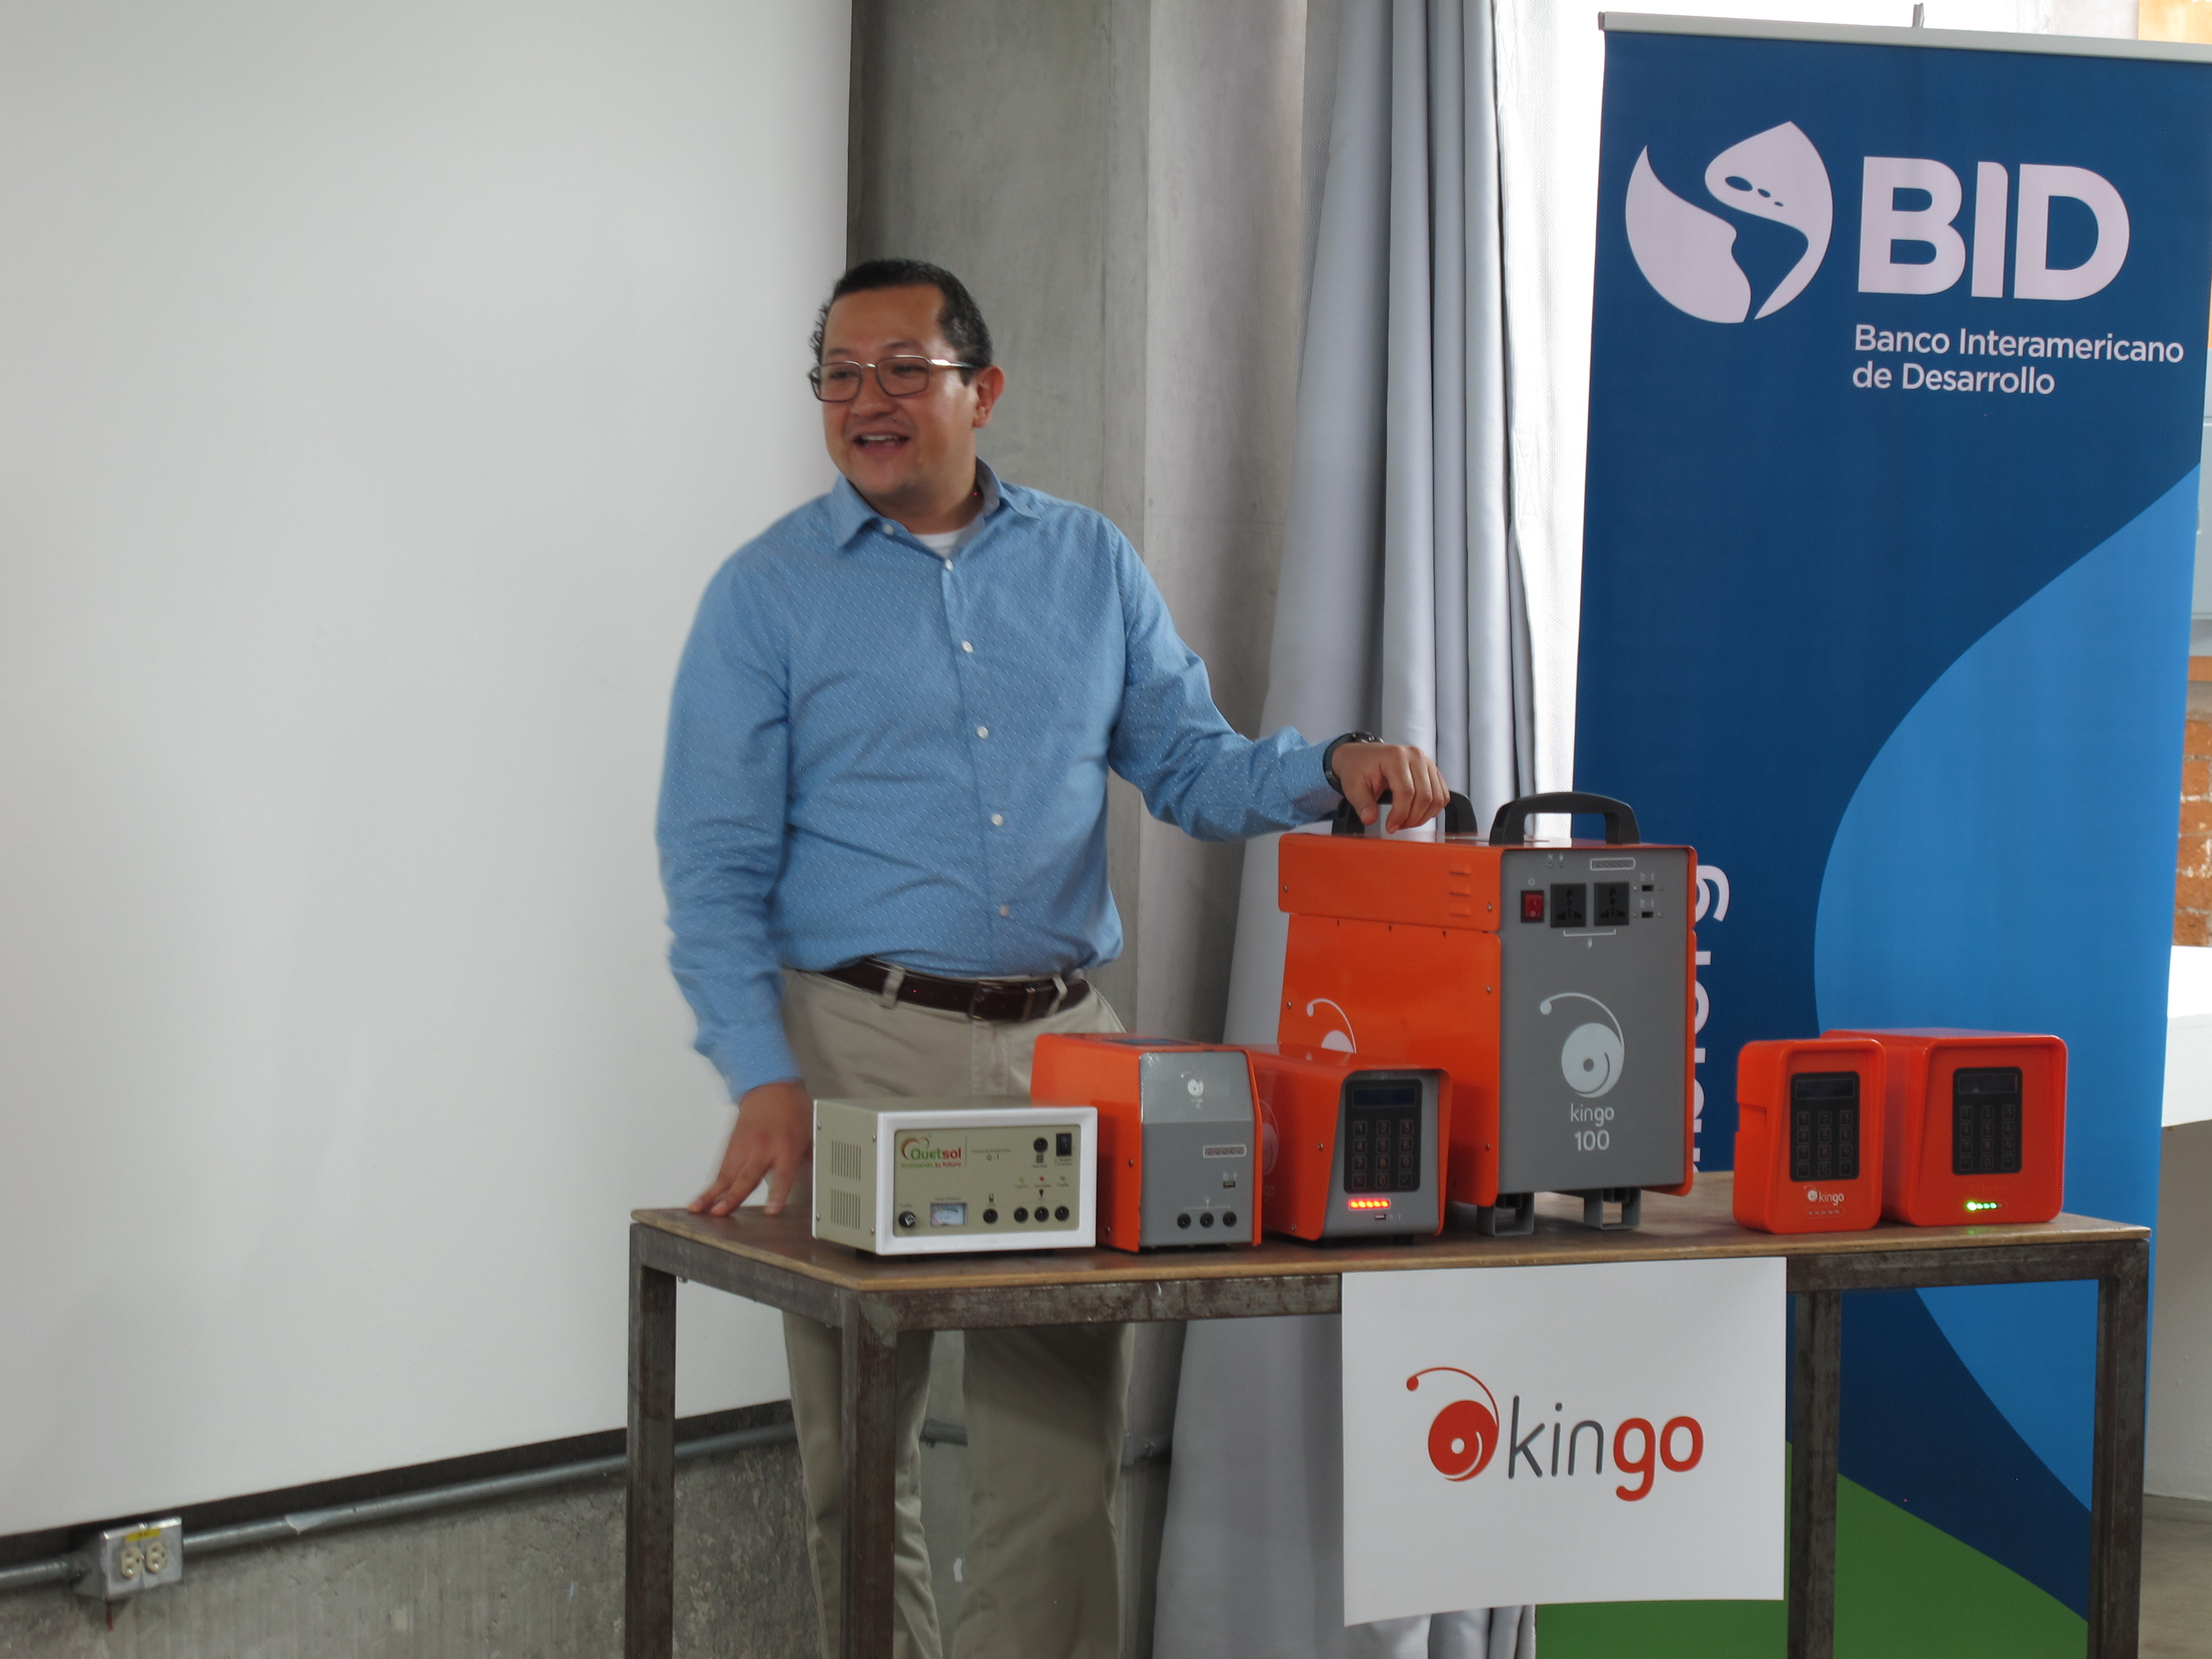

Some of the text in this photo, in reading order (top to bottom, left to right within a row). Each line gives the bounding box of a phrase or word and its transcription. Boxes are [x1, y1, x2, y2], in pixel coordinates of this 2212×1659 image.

[1858, 156, 2130, 301] BID
[1855, 324, 2184, 363] Banco Interamericano
[1852, 360, 2055, 394] de Desarrollo
[1570, 1102, 1615, 1127] kingo
[910, 1147, 962, 1160] Quetsol
[1575, 1130, 1610, 1151] 100
[1818, 1190, 1845, 1206] kingo
[1508, 1395, 1704, 1502] kingo
